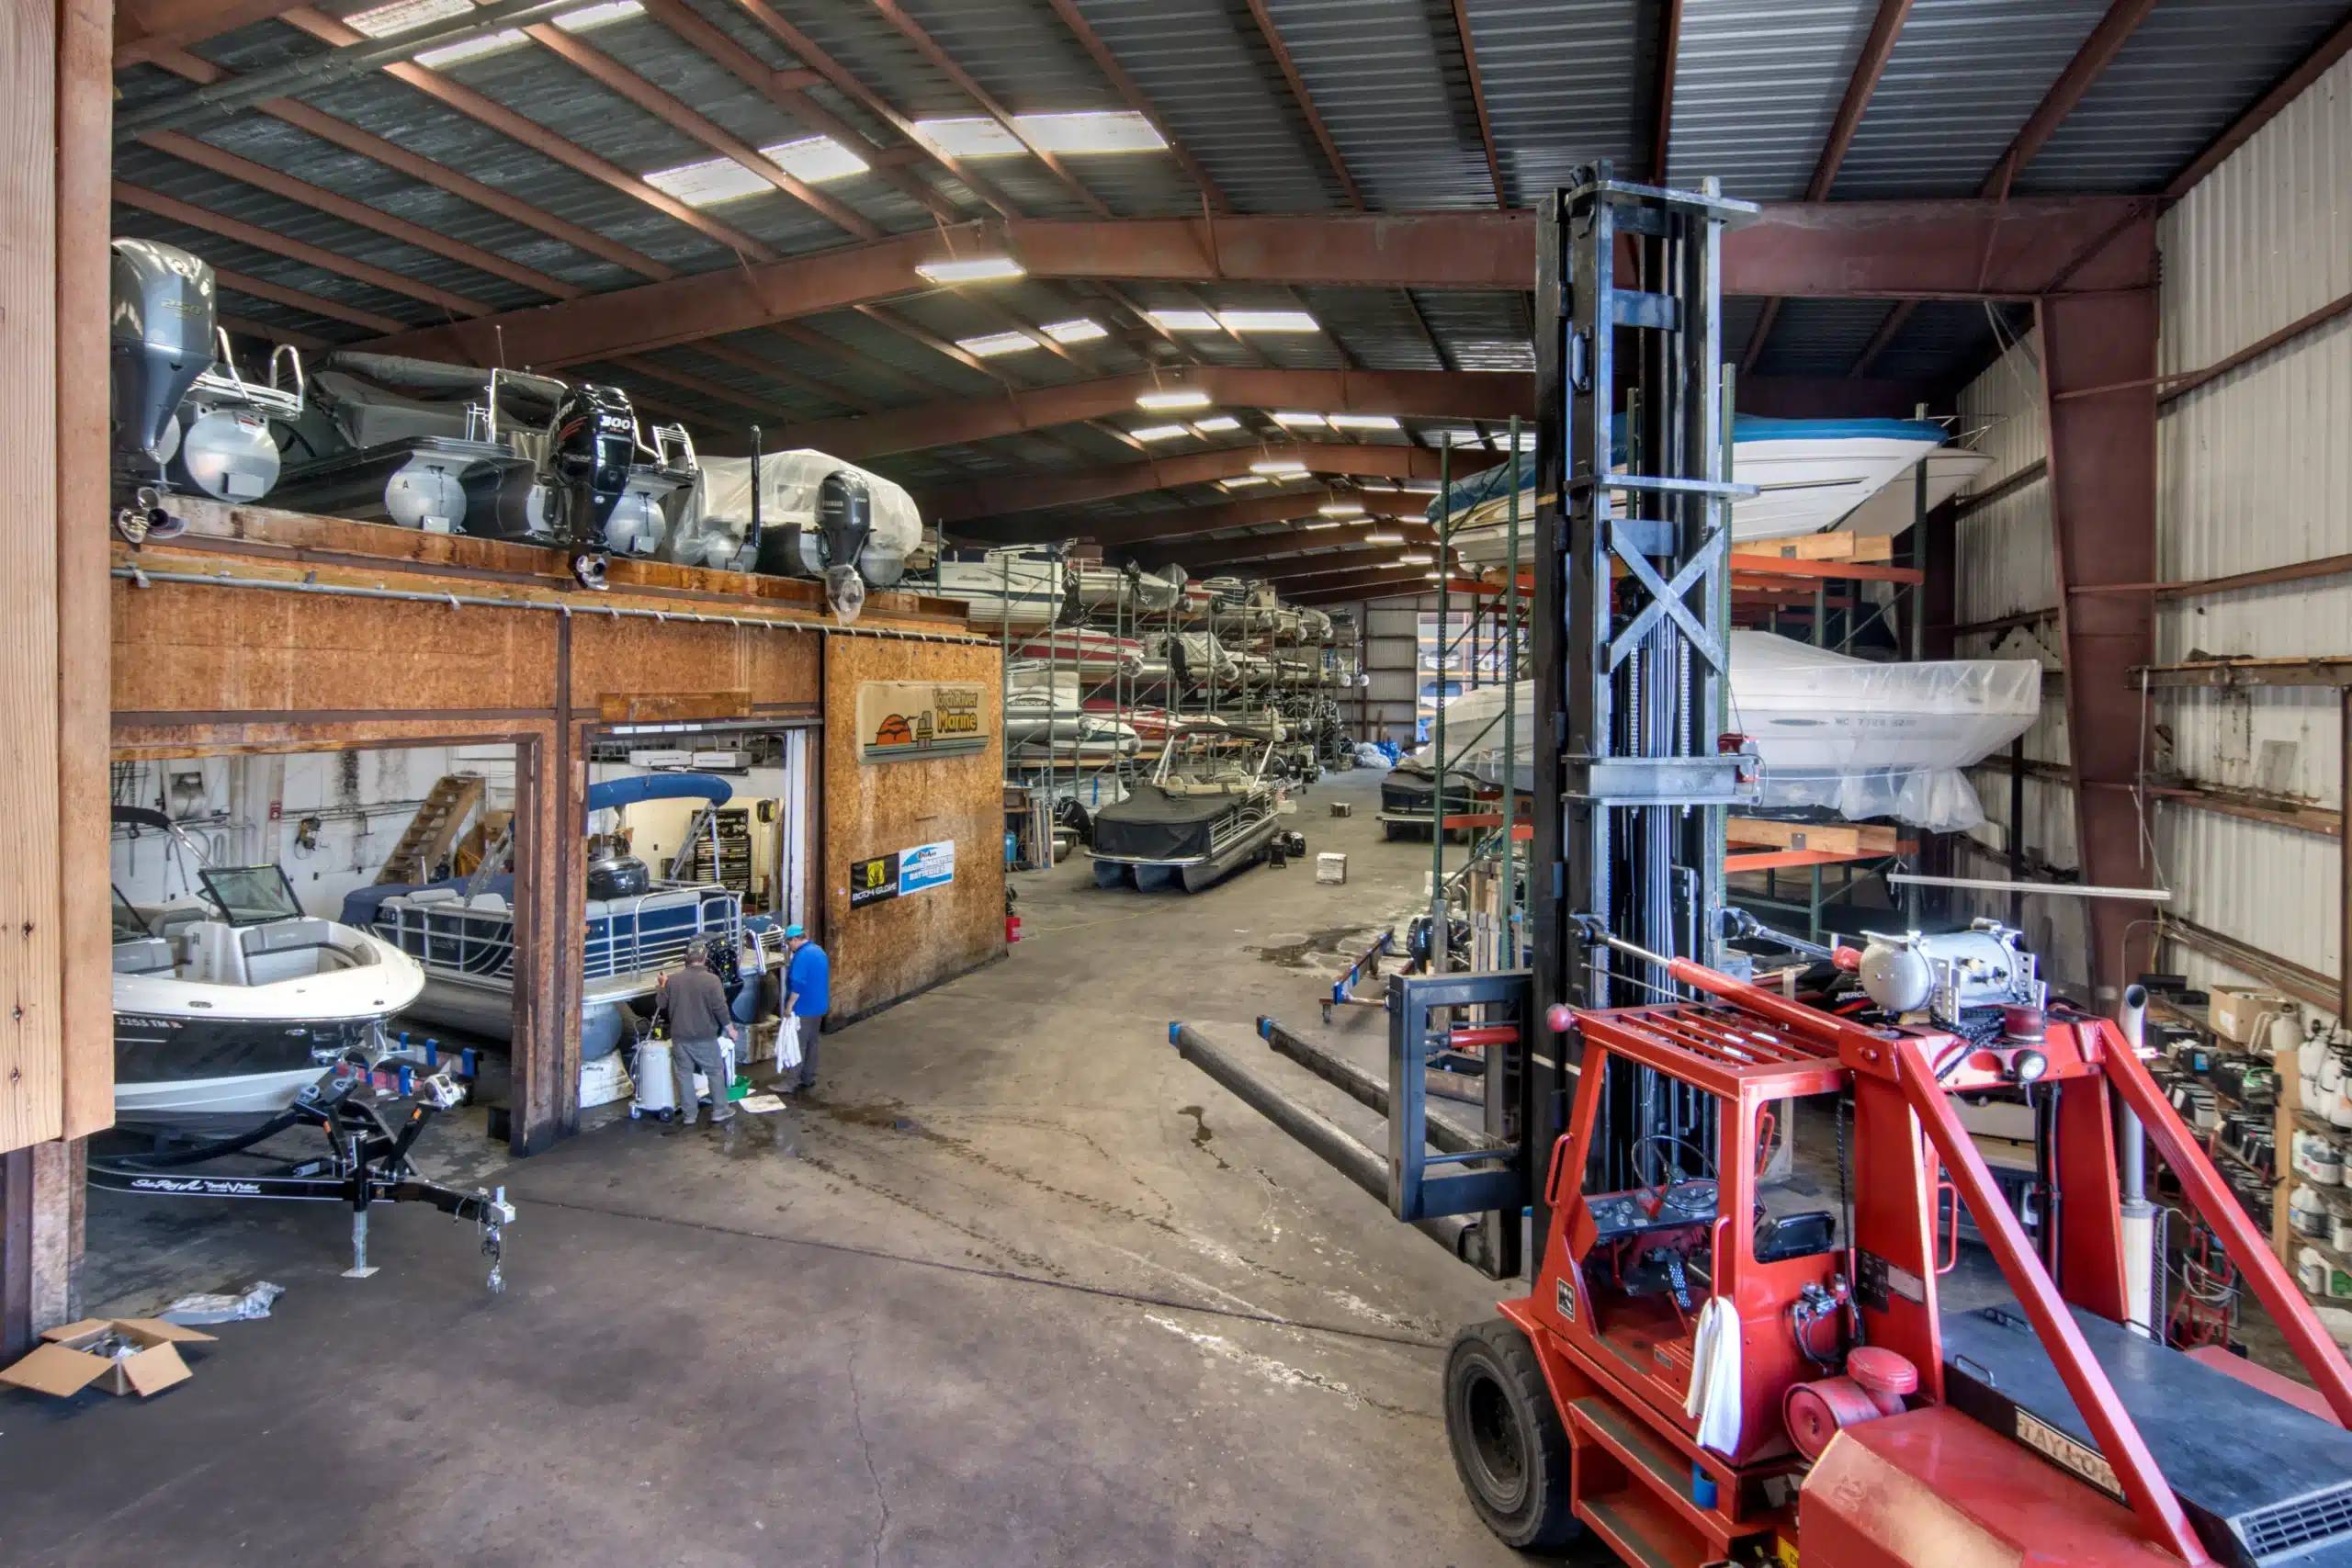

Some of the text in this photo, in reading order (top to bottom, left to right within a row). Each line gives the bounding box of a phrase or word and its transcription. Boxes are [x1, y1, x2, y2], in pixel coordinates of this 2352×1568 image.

[600, 415, 631, 429] 300
[937, 709, 978, 733] Marine
[875, 882, 898, 895] GLOVE
